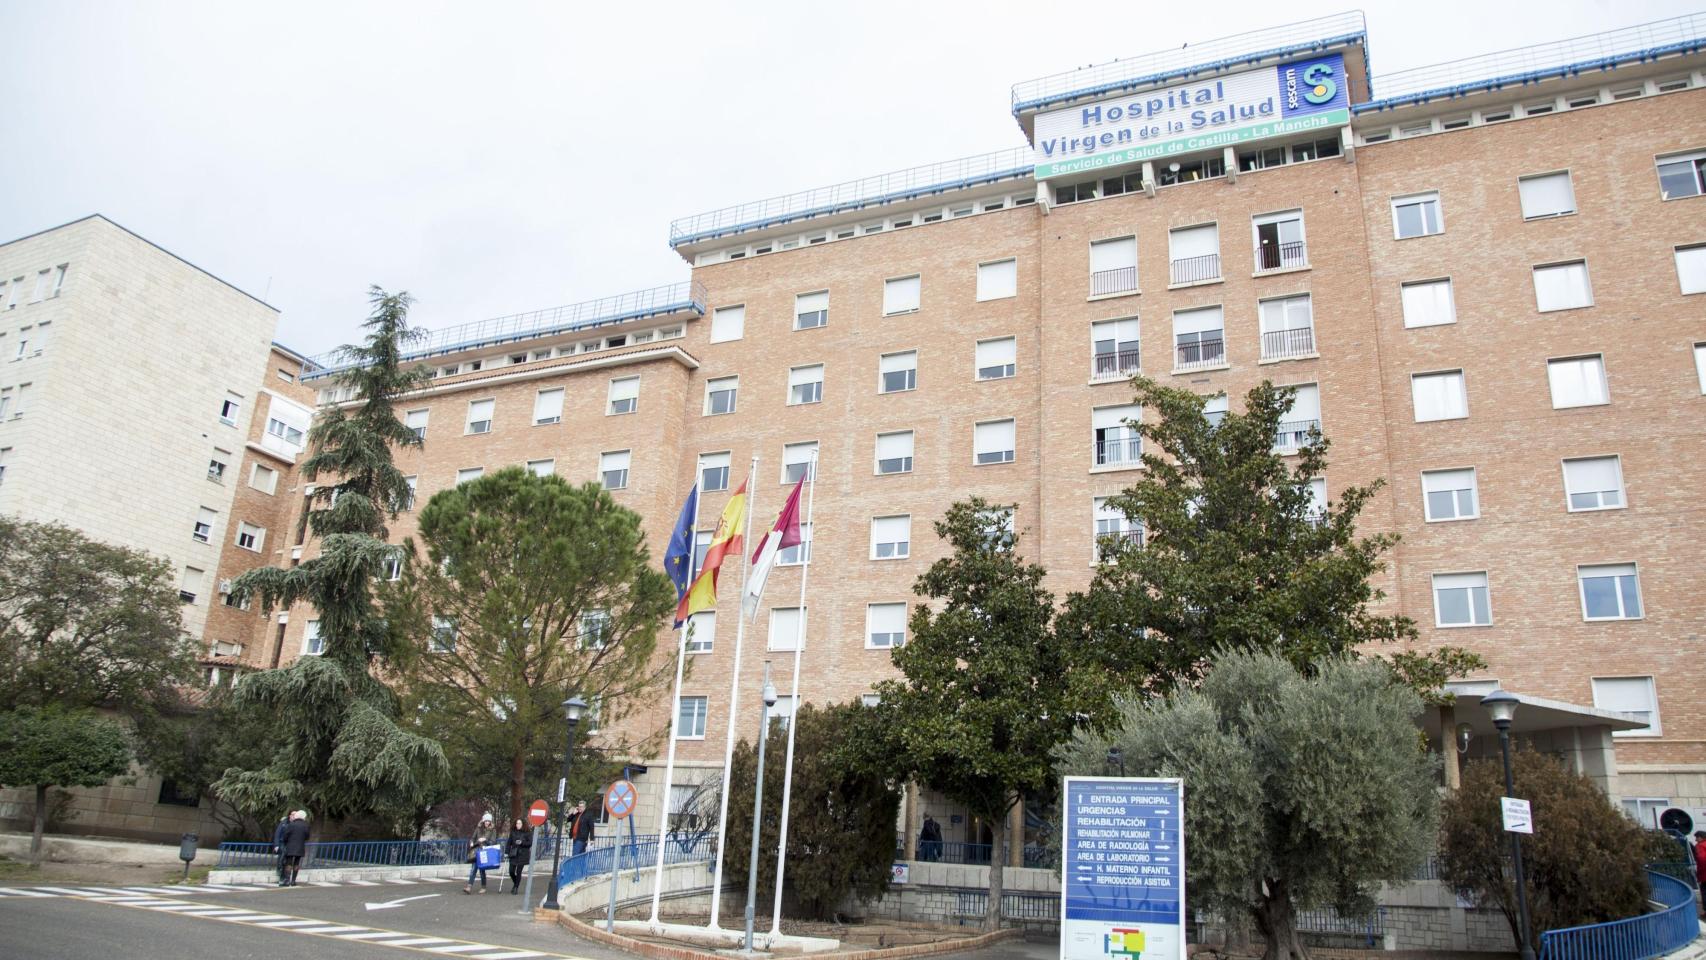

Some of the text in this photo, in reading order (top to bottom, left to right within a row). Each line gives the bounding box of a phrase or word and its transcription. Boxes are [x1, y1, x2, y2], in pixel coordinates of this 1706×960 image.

[1286, 68, 1299, 110] sescam
[1082, 81, 1224, 126] Hospital
[1041, 97, 1275, 155] Virgen de la Salud
[1051, 155, 1103, 174] Servicio
[1107, 150, 1123, 163] de
[1126, 145, 1163, 160] Salud
[1167, 140, 1184, 153] de
[1187, 131, 1239, 149] Castilla
[1252, 125, 1269, 138] La
[1273, 116, 1329, 133] Mancha
[1090, 795, 1170, 805] ENTRADA PRINCIPAL
[1077, 807, 1126, 815] URGENCIAS
[1077, 817, 1146, 827] REHABILITACIÓN
[1077, 829, 1150, 839] REHABILITACIÓN PULMONAR
[1077, 840, 1149, 851] AREA DE RADIOLOGÍA
[1077, 852, 1150, 862] AREA DE LABORATORIO
[1096, 865, 1170, 875] H. MATERNO INFANTIL
[1096, 876, 1171, 887] REPRODUCCIÓN ASISTIDA
